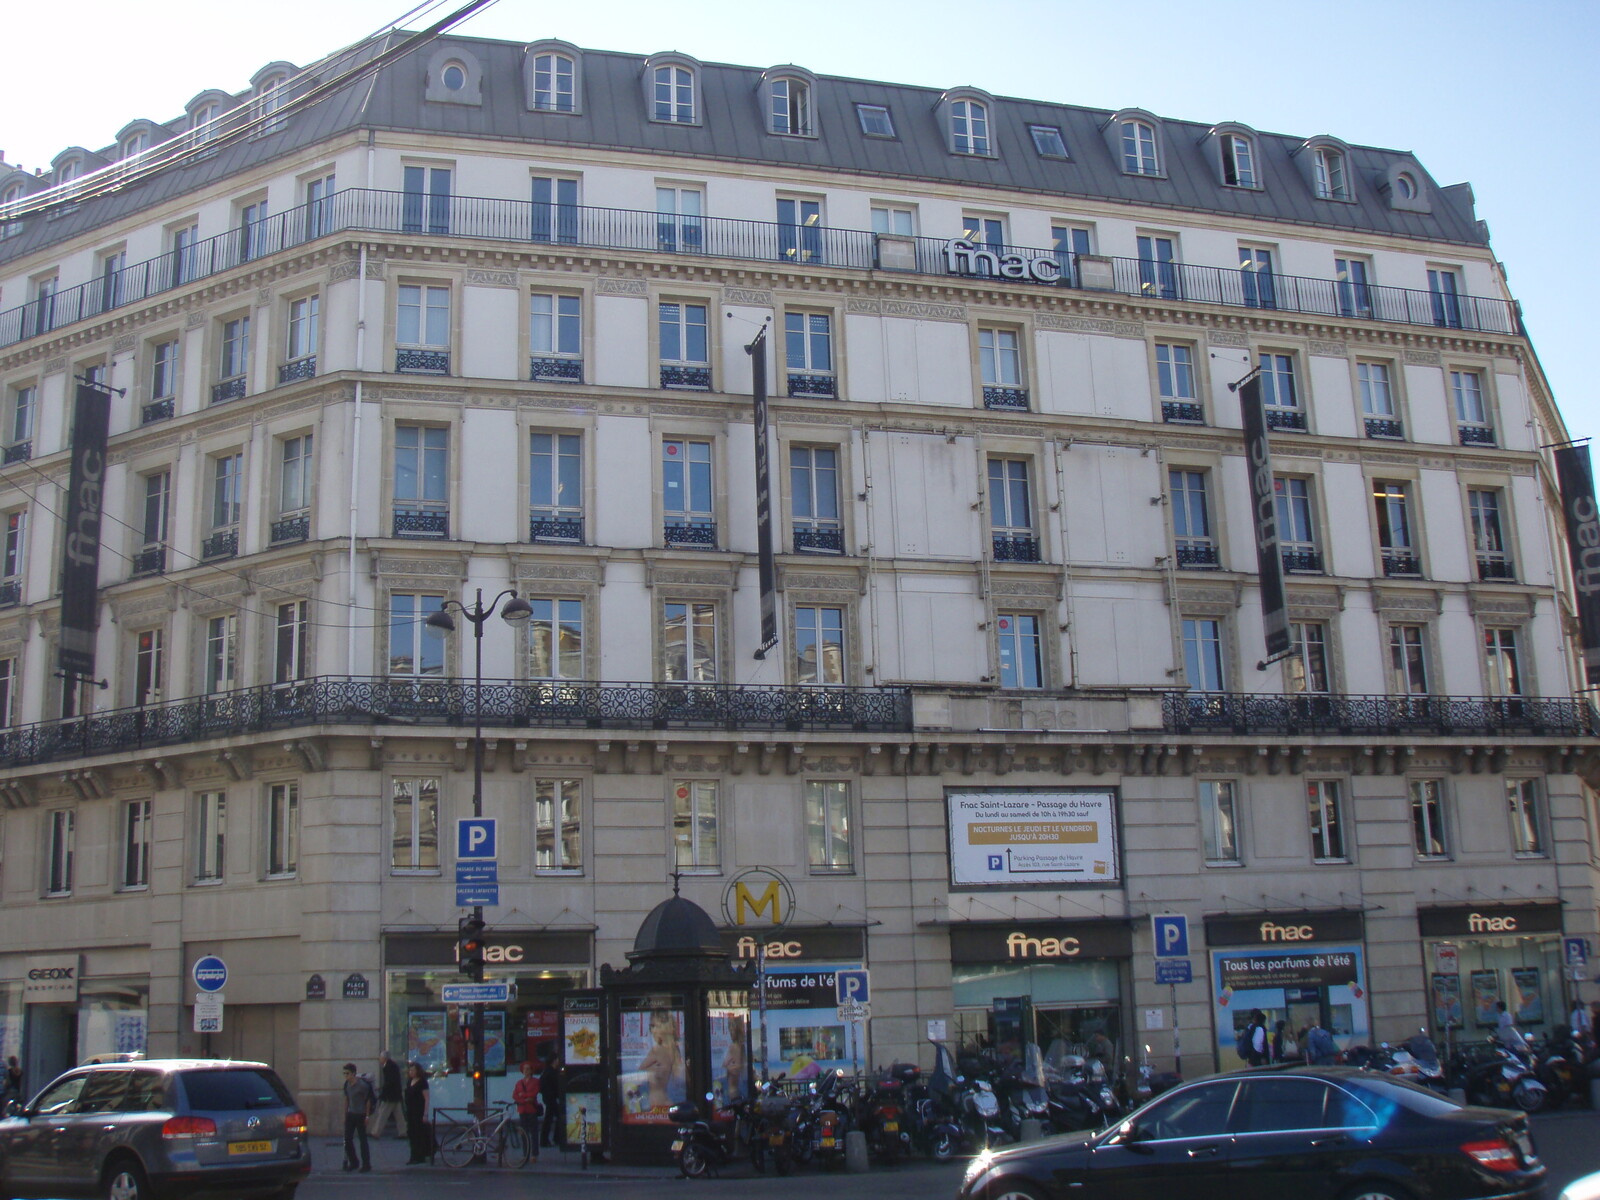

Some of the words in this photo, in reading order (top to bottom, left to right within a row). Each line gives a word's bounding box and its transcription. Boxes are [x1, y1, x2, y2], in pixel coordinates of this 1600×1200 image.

[944, 237, 1061, 283] fnac
[67, 449, 101, 567] fnac
[960, 801, 978, 809] Fnac
[980, 801, 1029, 809] Saint-Lazare
[1037, 801, 1067, 810] Passage
[469, 826, 487, 851] P
[973, 825, 1013, 833] NOCTURNES
[735, 880, 781, 925] M
[1260, 922, 1313, 940] fnac
[1467, 913, 1517, 932] fnac
[1006, 932, 1080, 957] fnac
[1164, 923, 1180, 951] P
[1223, 960, 1248, 972] Tous
[1251, 959, 1265, 970] les
[1267, 957, 1310, 971] parfums
[1312, 956, 1326, 966] de
[1328, 955, 1350, 967] l'été
[28, 967, 75, 980] GEOX
[800, 975, 815, 987] de
[819, 974, 837, 987] l'é
[846, 977, 860, 997] P
